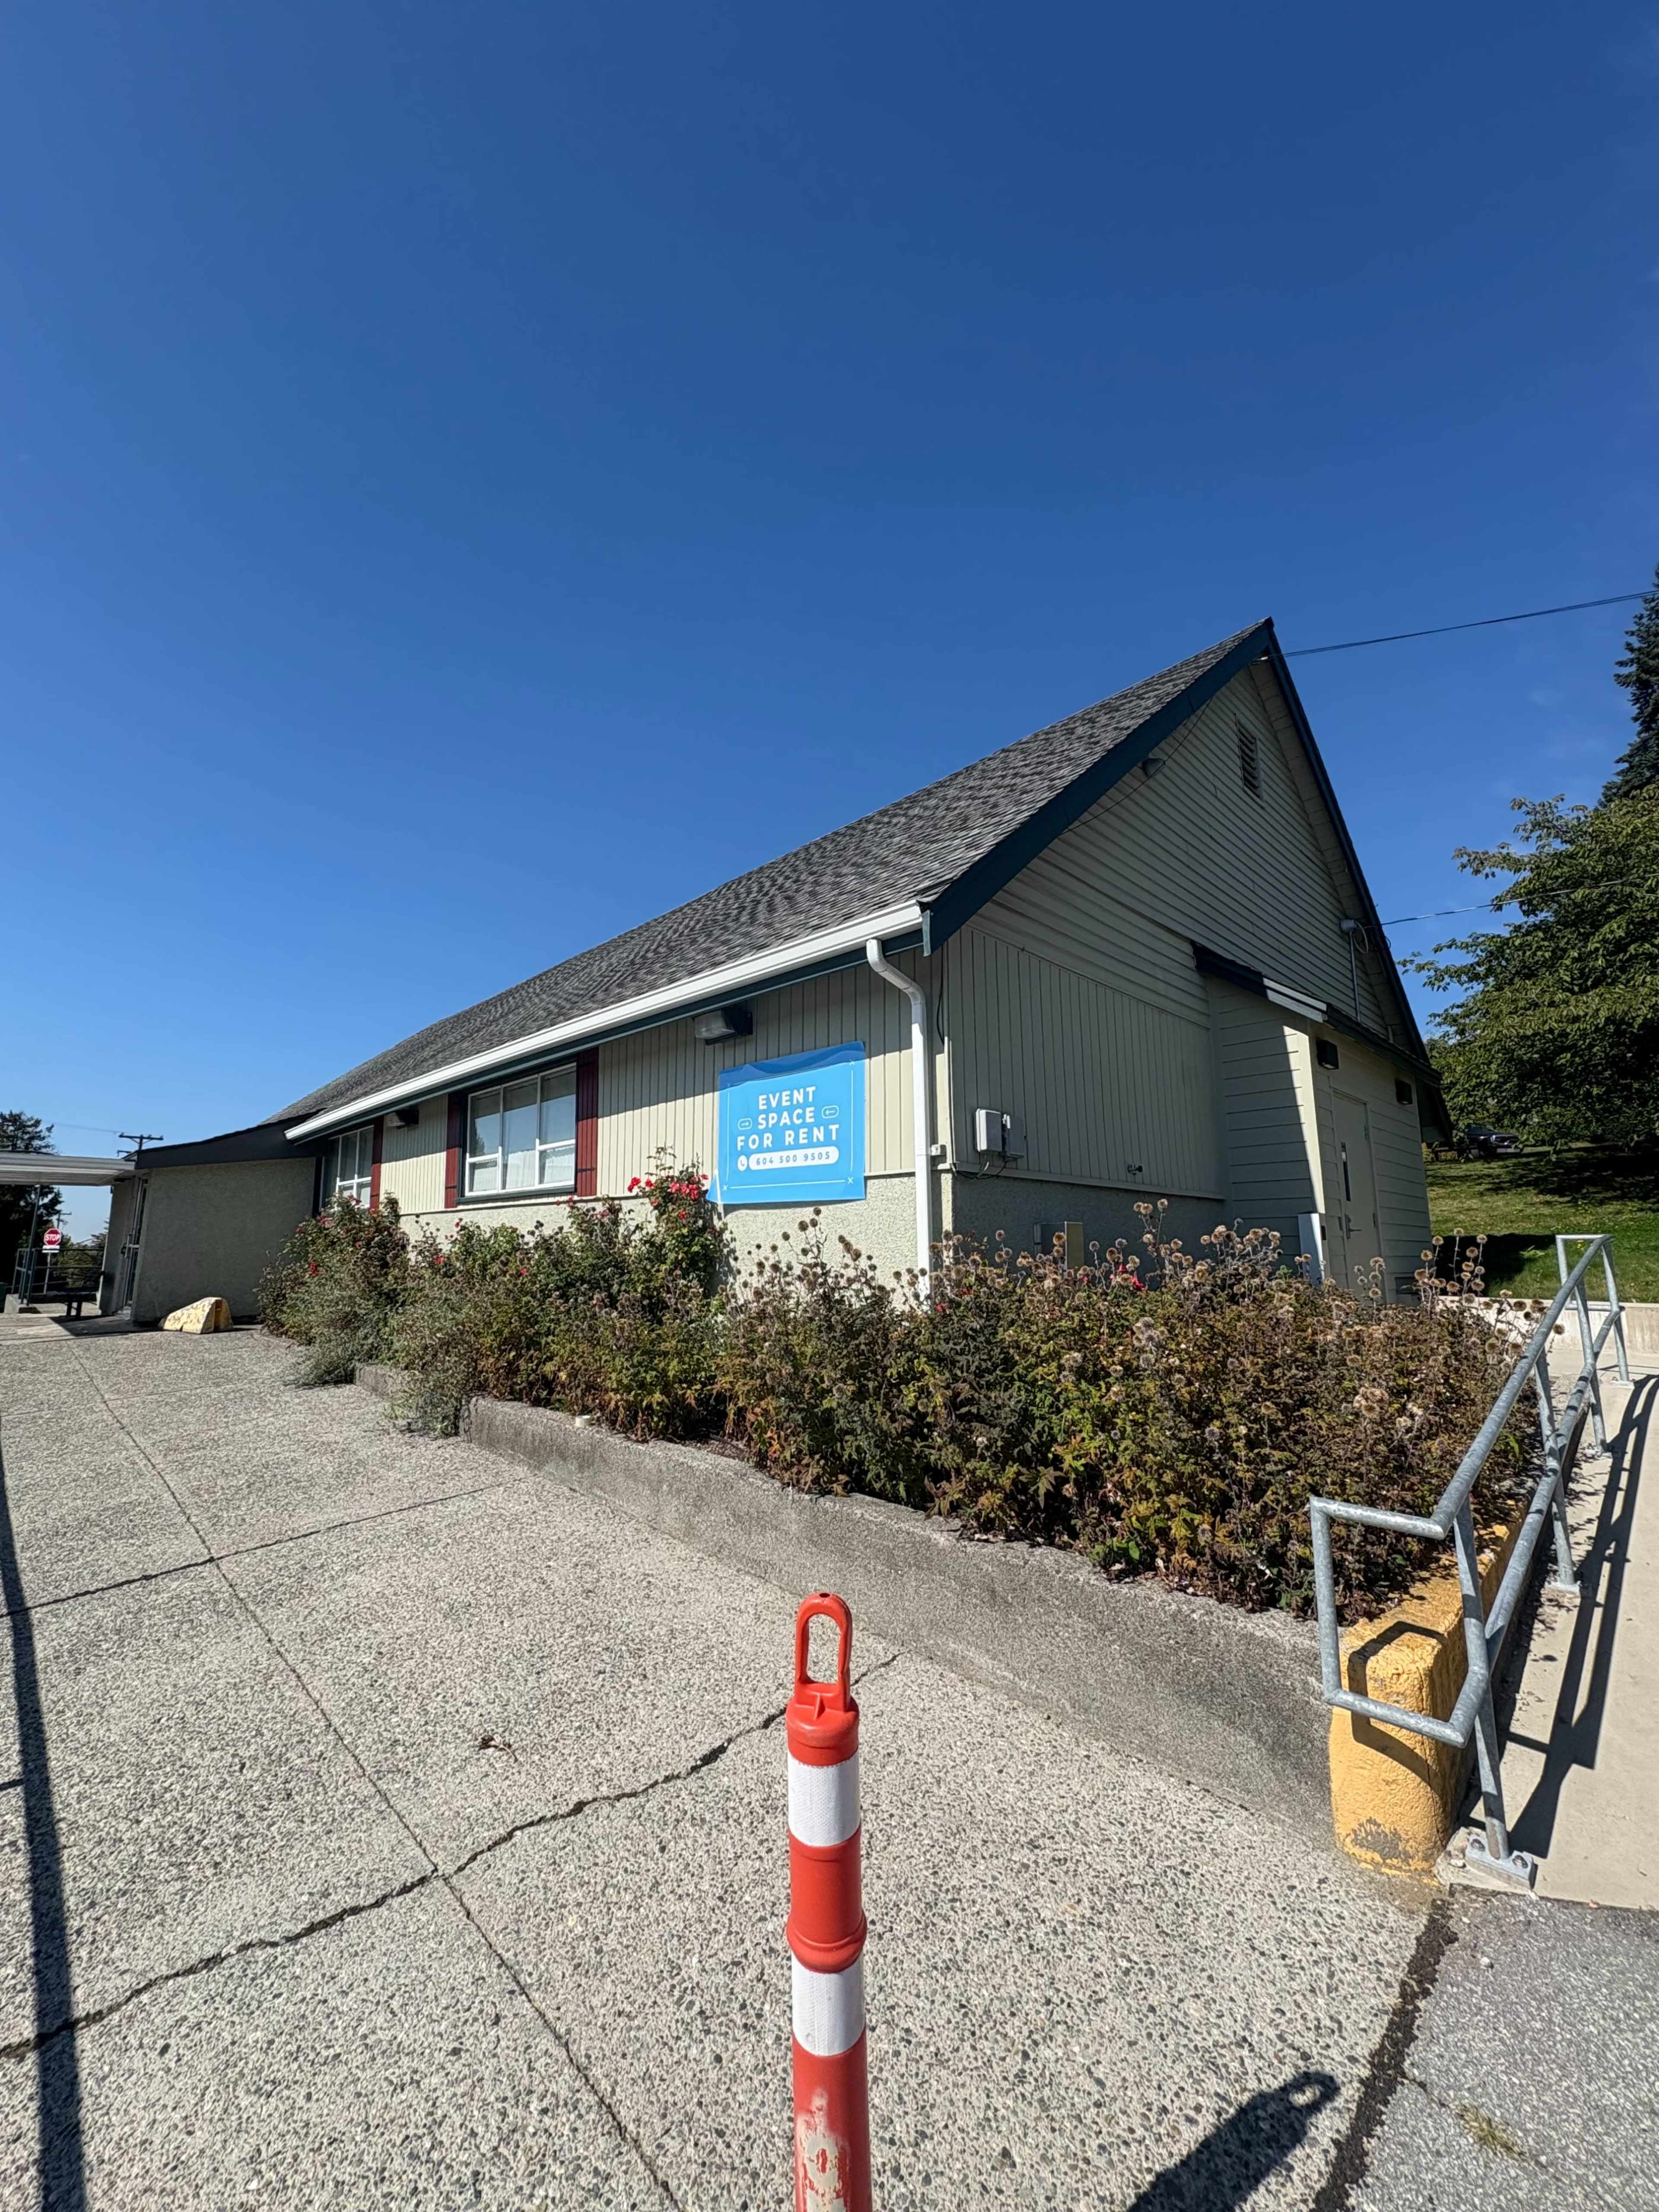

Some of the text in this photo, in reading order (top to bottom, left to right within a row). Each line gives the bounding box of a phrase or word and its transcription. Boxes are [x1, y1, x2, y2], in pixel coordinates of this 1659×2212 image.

[759, 1087, 816, 1109] EVENT
[758, 1107, 815, 1129] SPACE
[737, 1124, 839, 1150] FOR RENT
[756, 1151, 830, 1165] 604 500 9505
